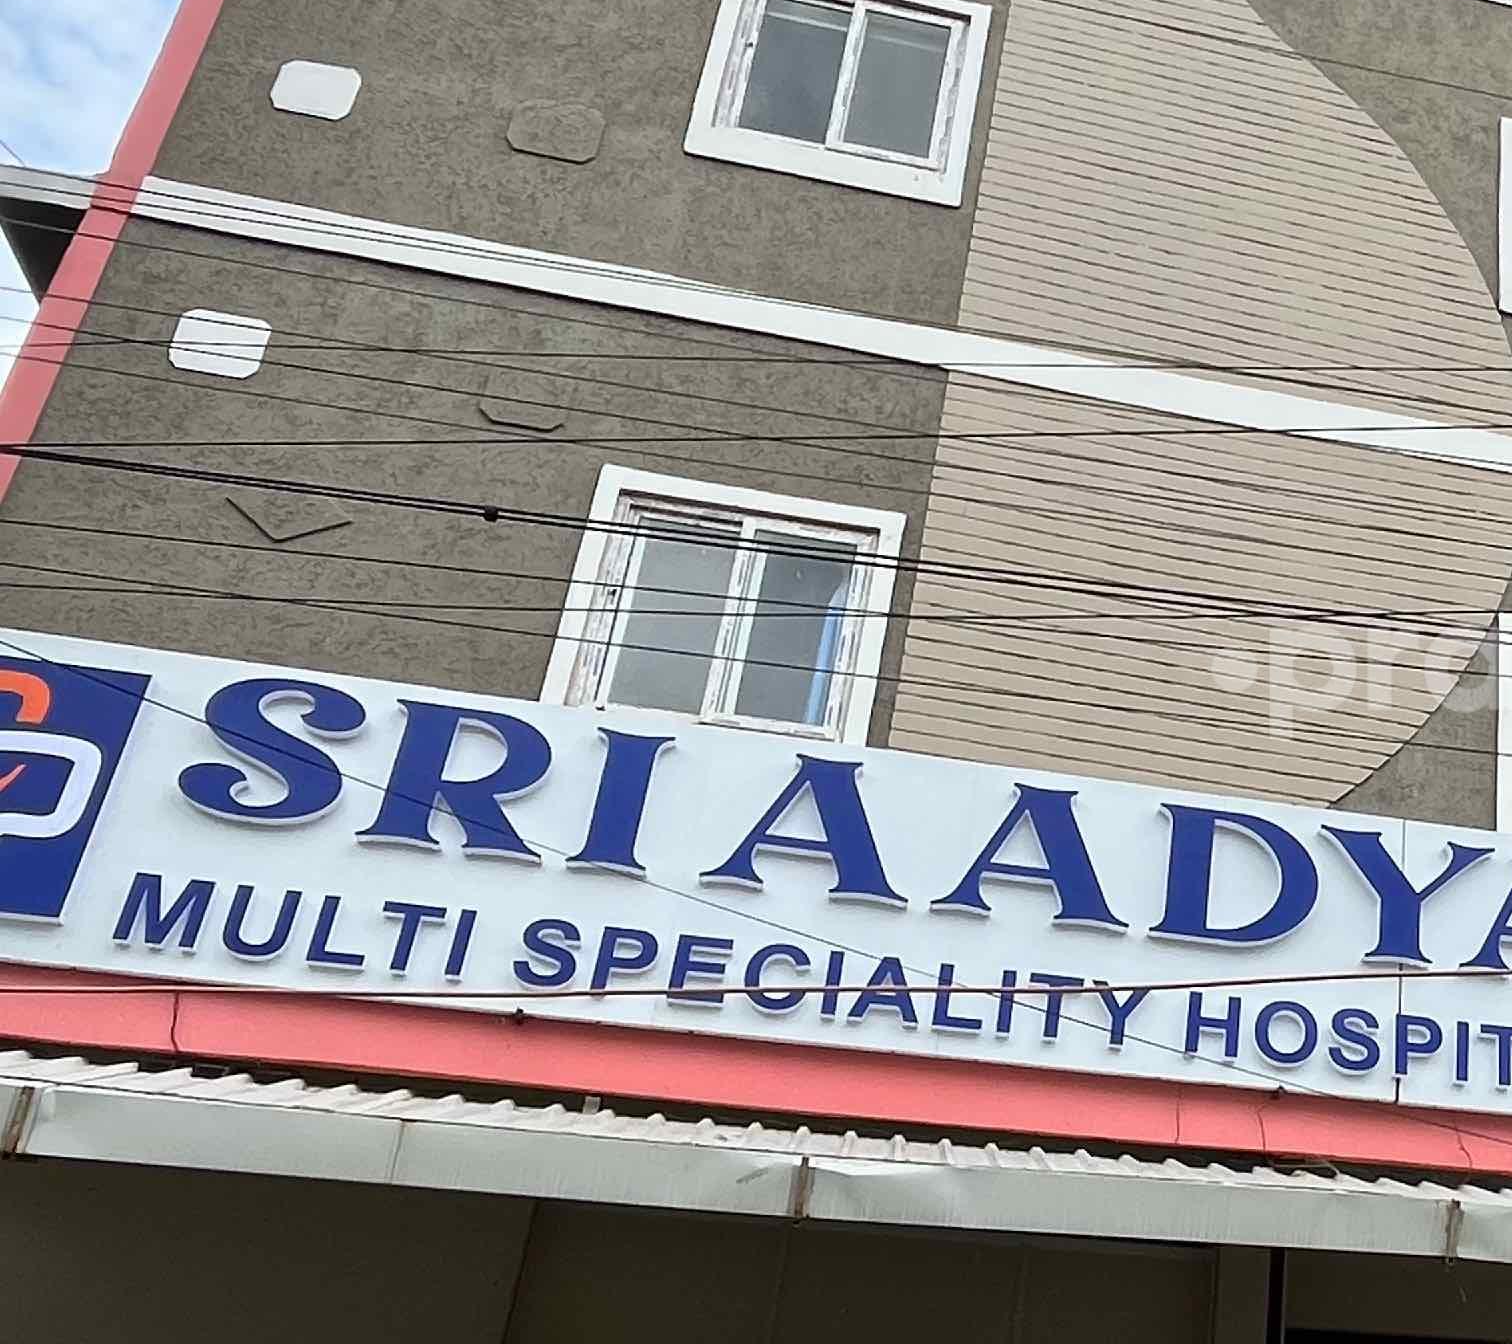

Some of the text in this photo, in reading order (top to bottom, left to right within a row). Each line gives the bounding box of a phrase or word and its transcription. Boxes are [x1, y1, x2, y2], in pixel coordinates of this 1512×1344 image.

[178, 676, 675, 879] SRI
[113, 872, 477, 982] MULTI
[512, 917, 1152, 1052] SPECIALITY
